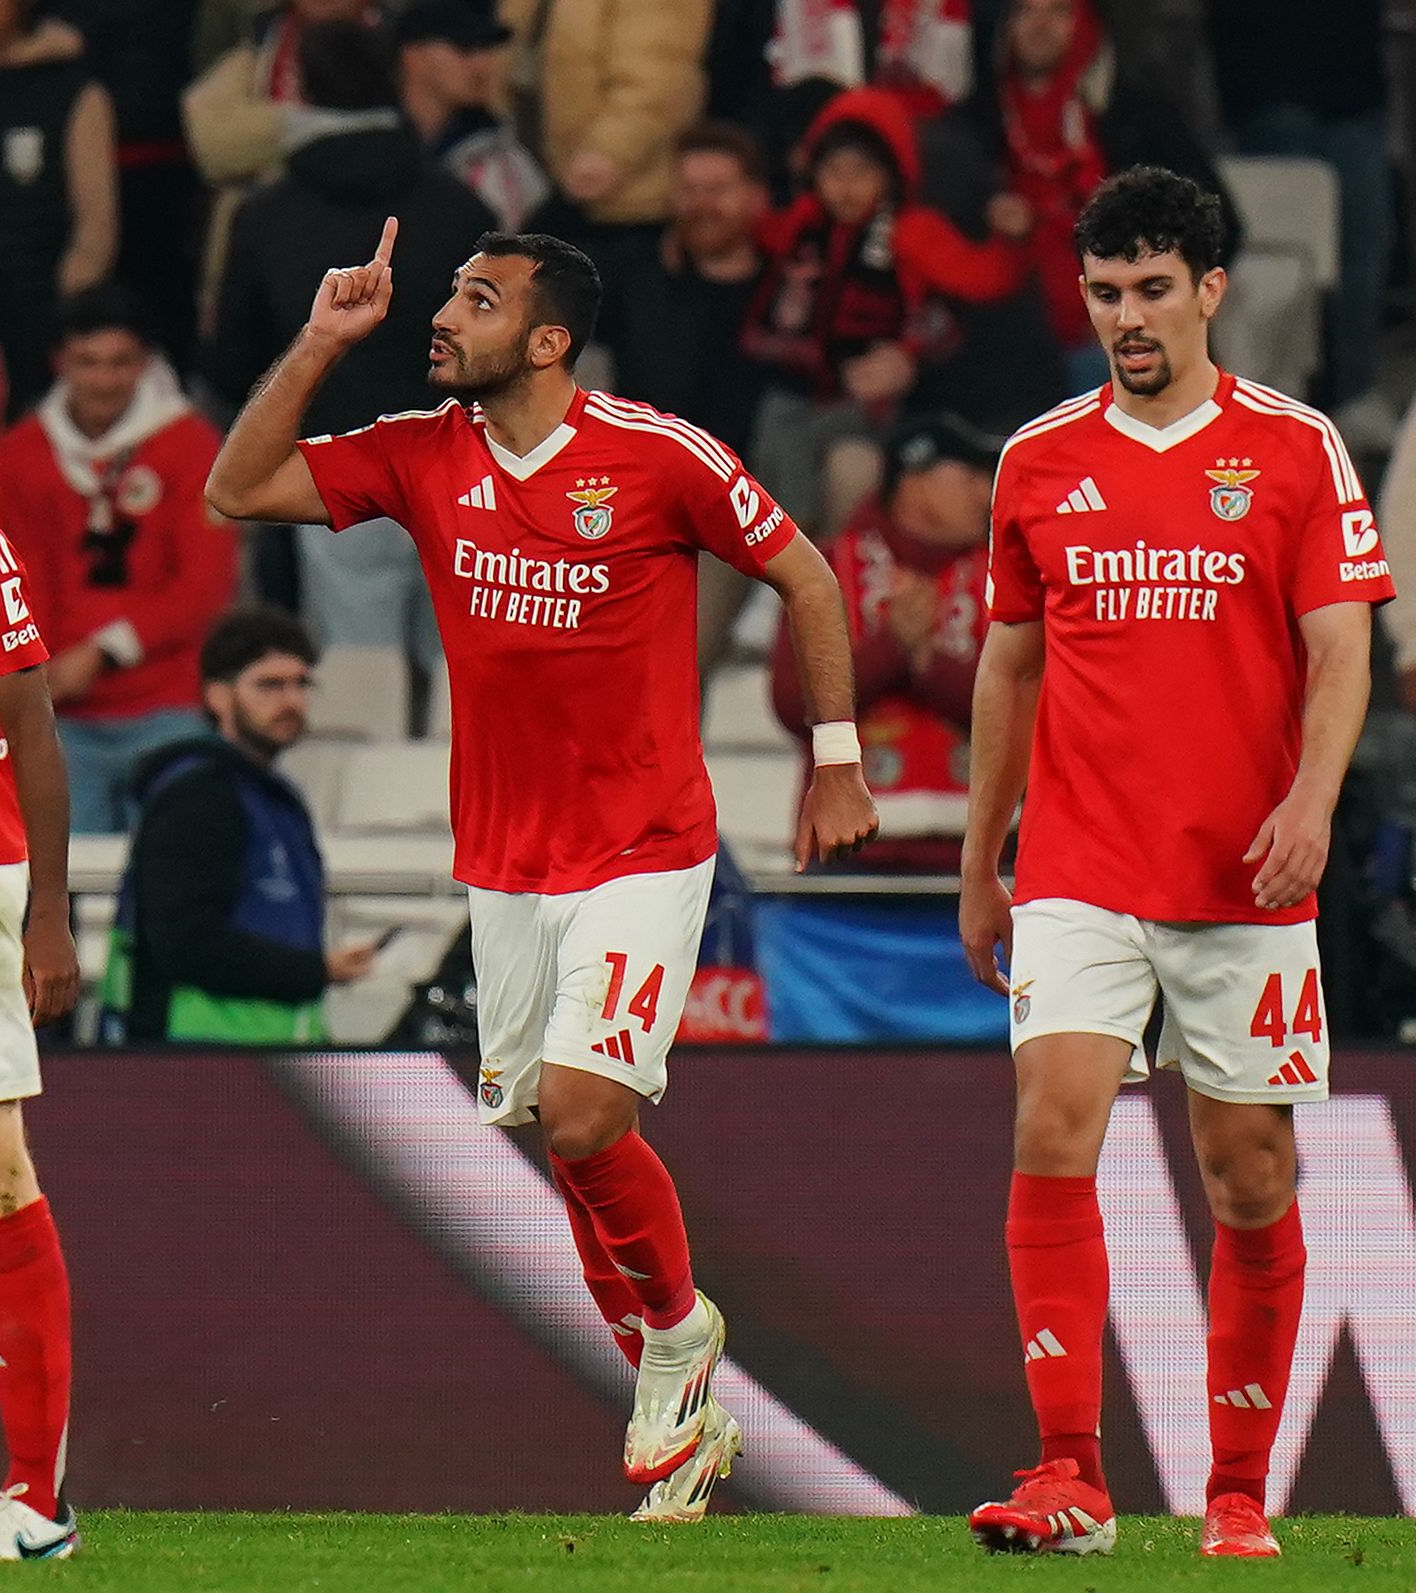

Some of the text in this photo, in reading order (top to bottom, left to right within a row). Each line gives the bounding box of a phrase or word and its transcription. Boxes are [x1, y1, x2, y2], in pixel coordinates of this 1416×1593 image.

[454, 538, 610, 594] Emirates
[1064, 539, 1246, 586] Emirates
[1339, 560, 1391, 582] Betan
[470, 586, 581, 629] FLY BETTER
[1096, 587, 1219, 621] FLY BETTER
[601, 951, 665, 1035] 14
[1249, 968, 1322, 1049] 44
